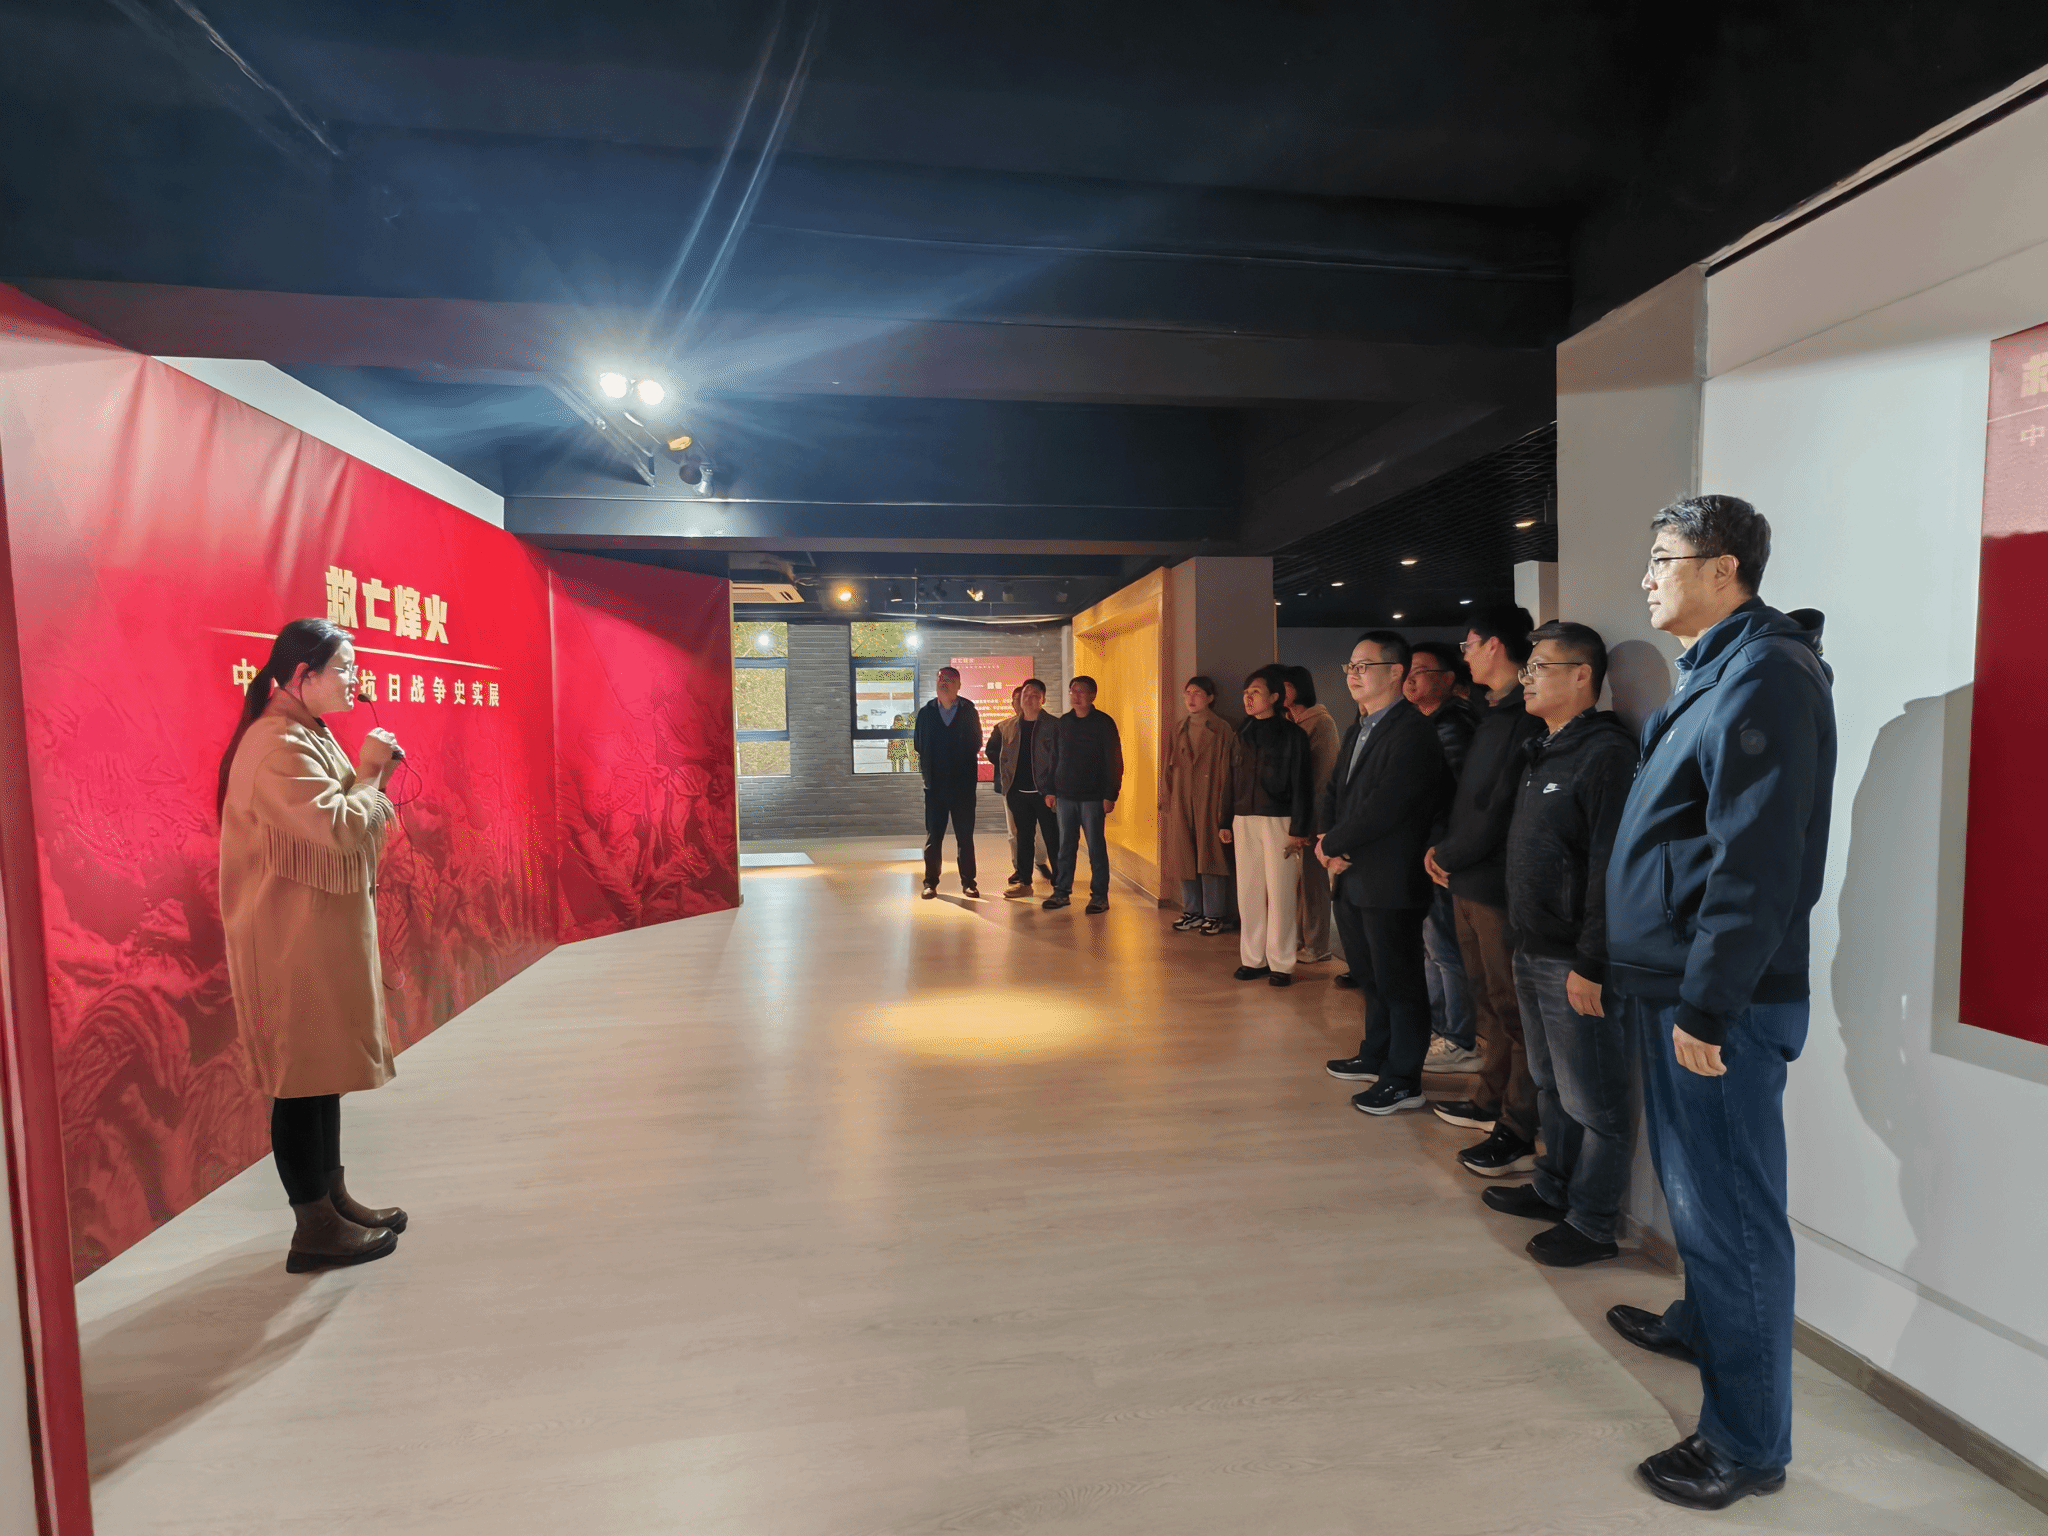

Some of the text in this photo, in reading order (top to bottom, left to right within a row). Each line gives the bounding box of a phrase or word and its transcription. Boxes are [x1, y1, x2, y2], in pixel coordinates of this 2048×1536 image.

[2020, 424, 2046, 447] 中
[325, 565, 449, 645] 救亡烽火
[232, 658, 500, 707] 中抗日战争史实展
